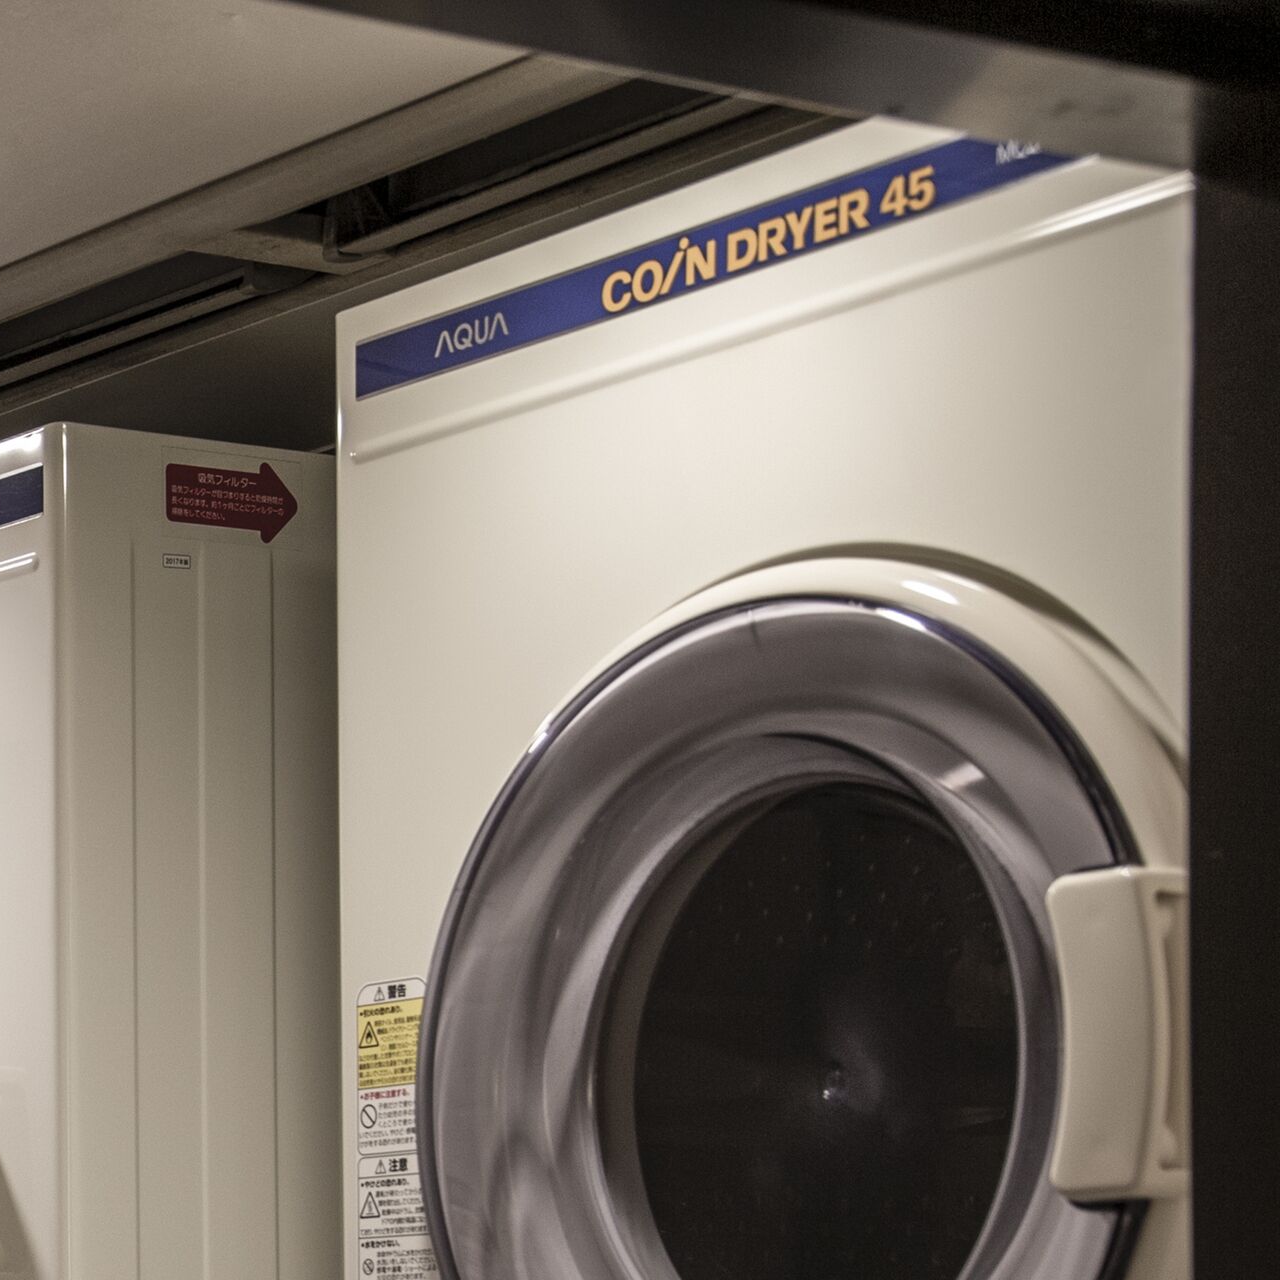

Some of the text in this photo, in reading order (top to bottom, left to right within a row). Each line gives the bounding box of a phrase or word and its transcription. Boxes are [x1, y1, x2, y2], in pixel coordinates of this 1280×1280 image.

[725, 188, 870, 273] DRYER
[878, 165, 935, 215] 45
[435, 311, 508, 358] AQUA
[197, 473, 257, 488] 吸気フィルター
[387, 984, 407, 999] 警告
[388, 1158, 408, 1172] 注意
